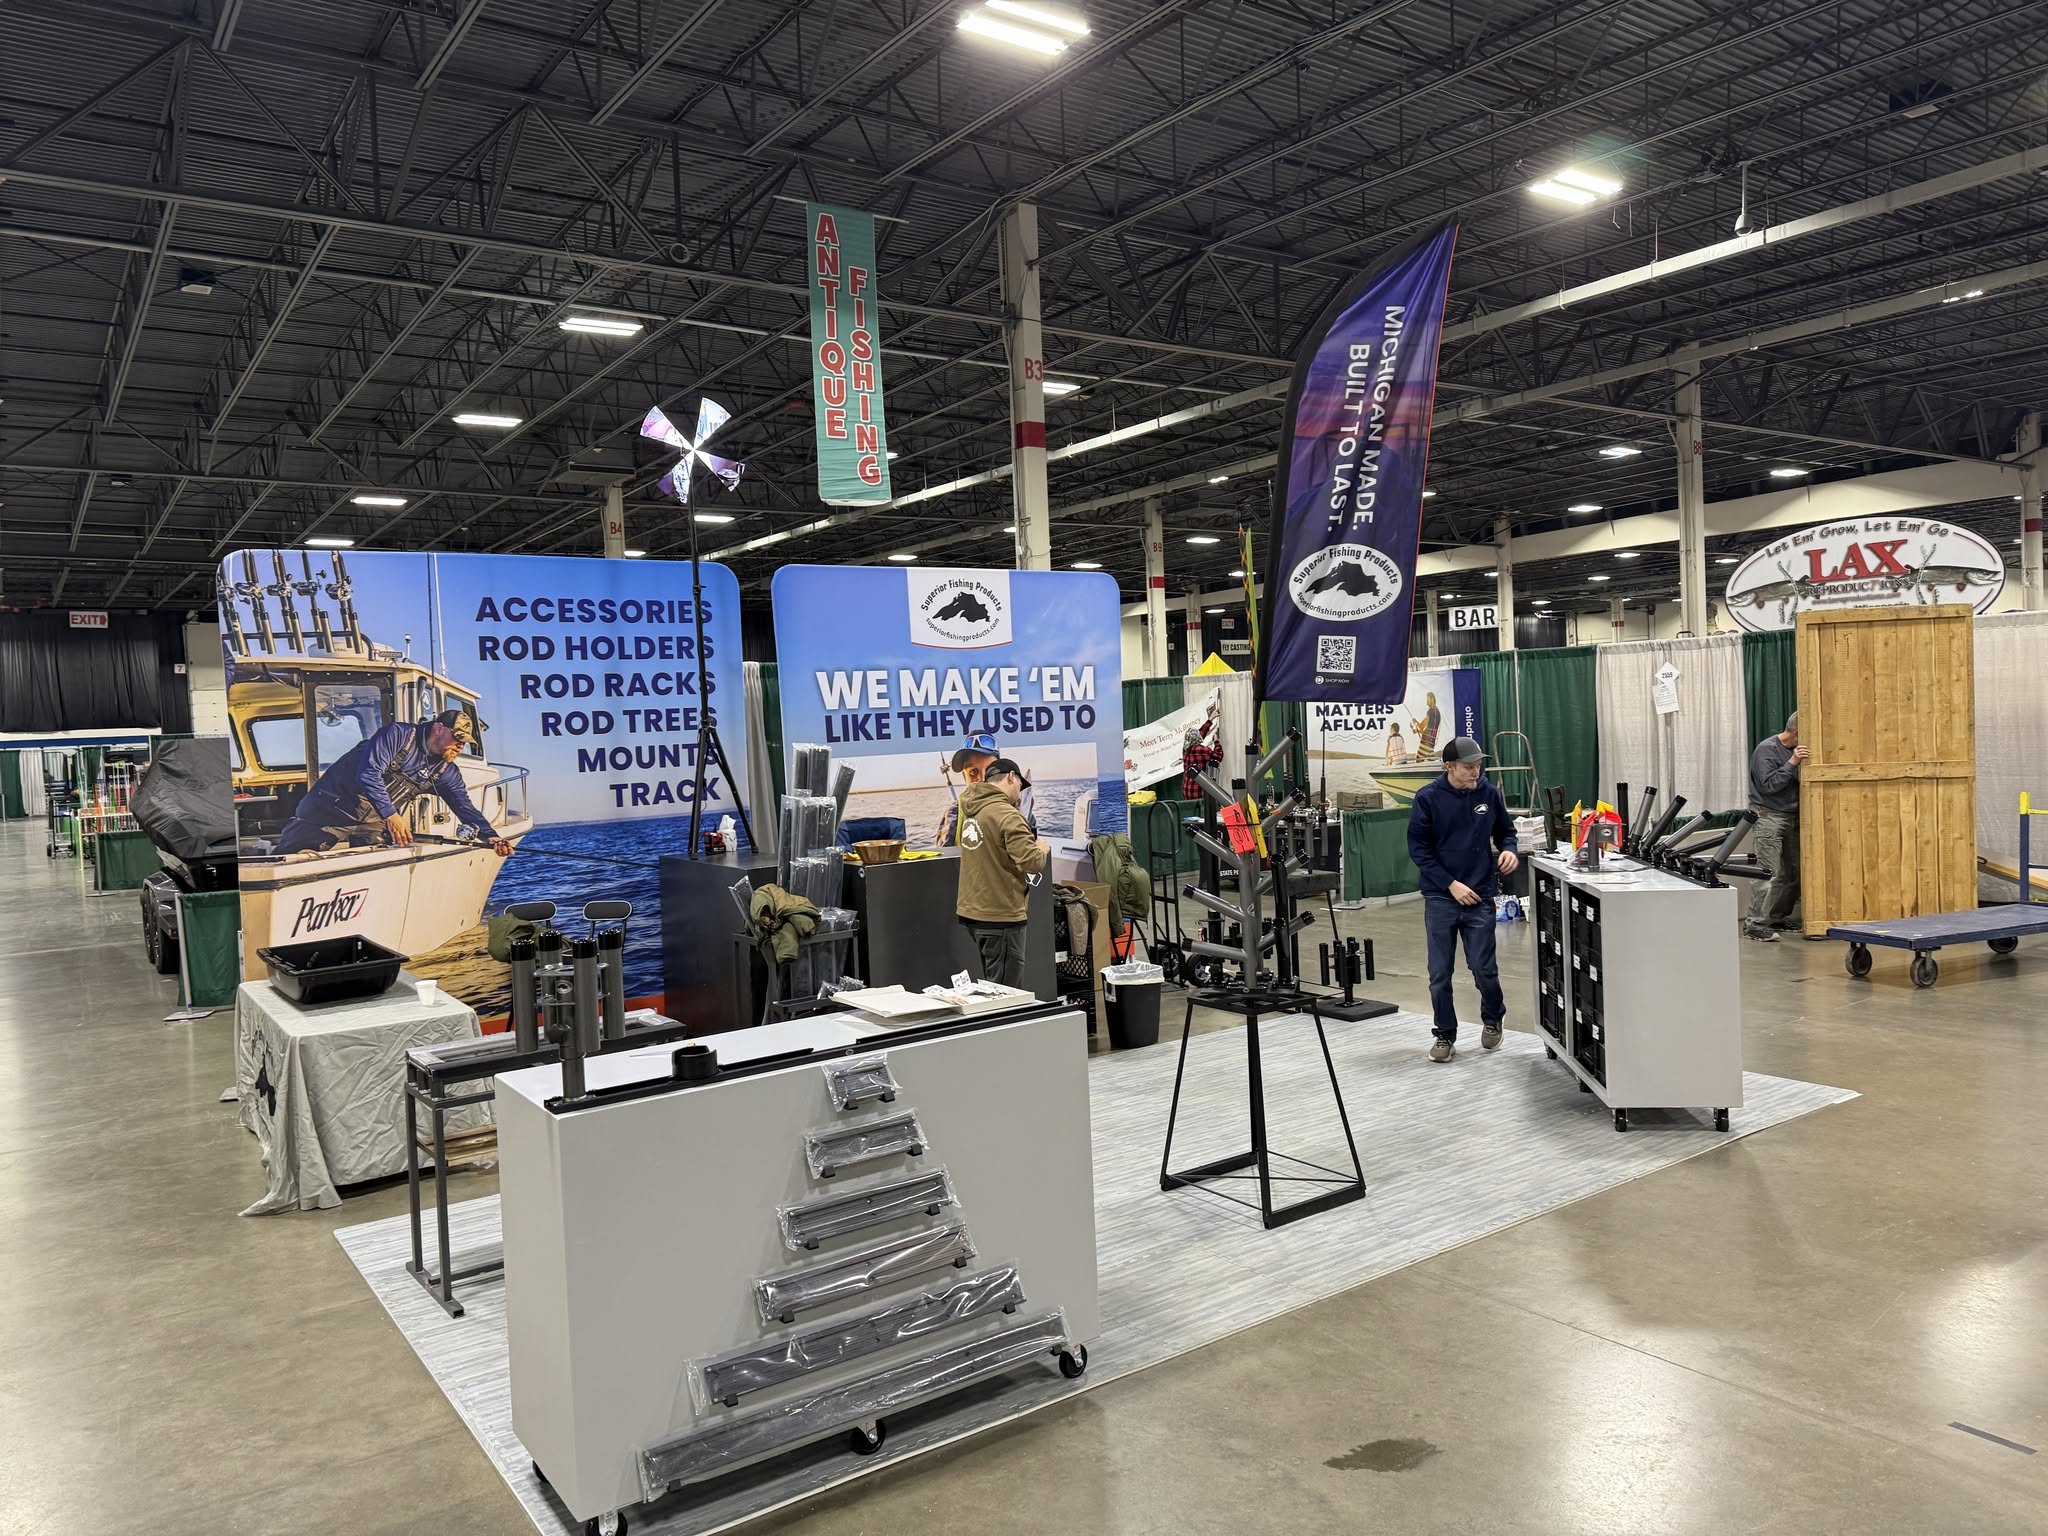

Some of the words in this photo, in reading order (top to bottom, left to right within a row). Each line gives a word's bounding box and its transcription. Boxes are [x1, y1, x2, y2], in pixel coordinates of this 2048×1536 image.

[815, 213, 847, 439] ANTIQUE
[849, 266, 882, 485] FISHING
[1025, 357, 1043, 381] B3
[1344, 344, 1370, 414] BUILT
[1367, 305, 1405, 441] MICHIGAN
[1338, 422, 1363, 457] TO
[1328, 464, 1353, 532] LAST.
[1353, 450, 1381, 531] MADE.
[610, 521, 622, 534] B4
[1765, 541, 1789, 558] Let
[1820, 525, 1858, 539] Grow,
[1864, 520, 1891, 532] Let
[1927, 523, 1949, 537] Go
[1293, 552, 1326, 584] Superior
[1329, 547, 1361, 560] Fishing
[1363, 550, 1398, 585] Products
[1803, 539, 1911, 584] LAX
[921, 583, 947, 611] Superior
[948, 579, 974, 590] Fishing
[975, 582, 1002, 611] Products
[1808, 577, 1910, 595] REPRODUCTIONS
[71, 614, 99, 625] EXIT
[475, 597, 713, 624] ACCESSORIES
[1297, 591, 1393, 618] superiorfishingproducts.com
[1455, 608, 1495, 627] BAR
[926, 617, 1000, 642] superiorfishingproducts.com
[478, 635, 555, 661] ROD
[565, 635, 714, 661] HOLDERS
[520, 674, 595, 699] ROD
[604, 671, 716, 697] RACKS
[815, 670, 890, 710] WE
[899, 667, 1020, 707] MAKE
[541, 711, 614, 737] ROD
[623, 707, 718, 734] TREES
[825, 712, 891, 743] LIKE
[897, 708, 975, 739] THEY
[983, 706, 1054, 734] USED
[1060, 704, 1096, 731] TO
[1316, 703, 1394, 717] MATTERS
[1321, 718, 1387, 731] AFLOAT
[1139, 739, 1157, 748] Meet
[1157, 733, 1173, 742] Terry
[609, 777, 721, 808] TRACK
[290, 888, 360, 938] Parker
